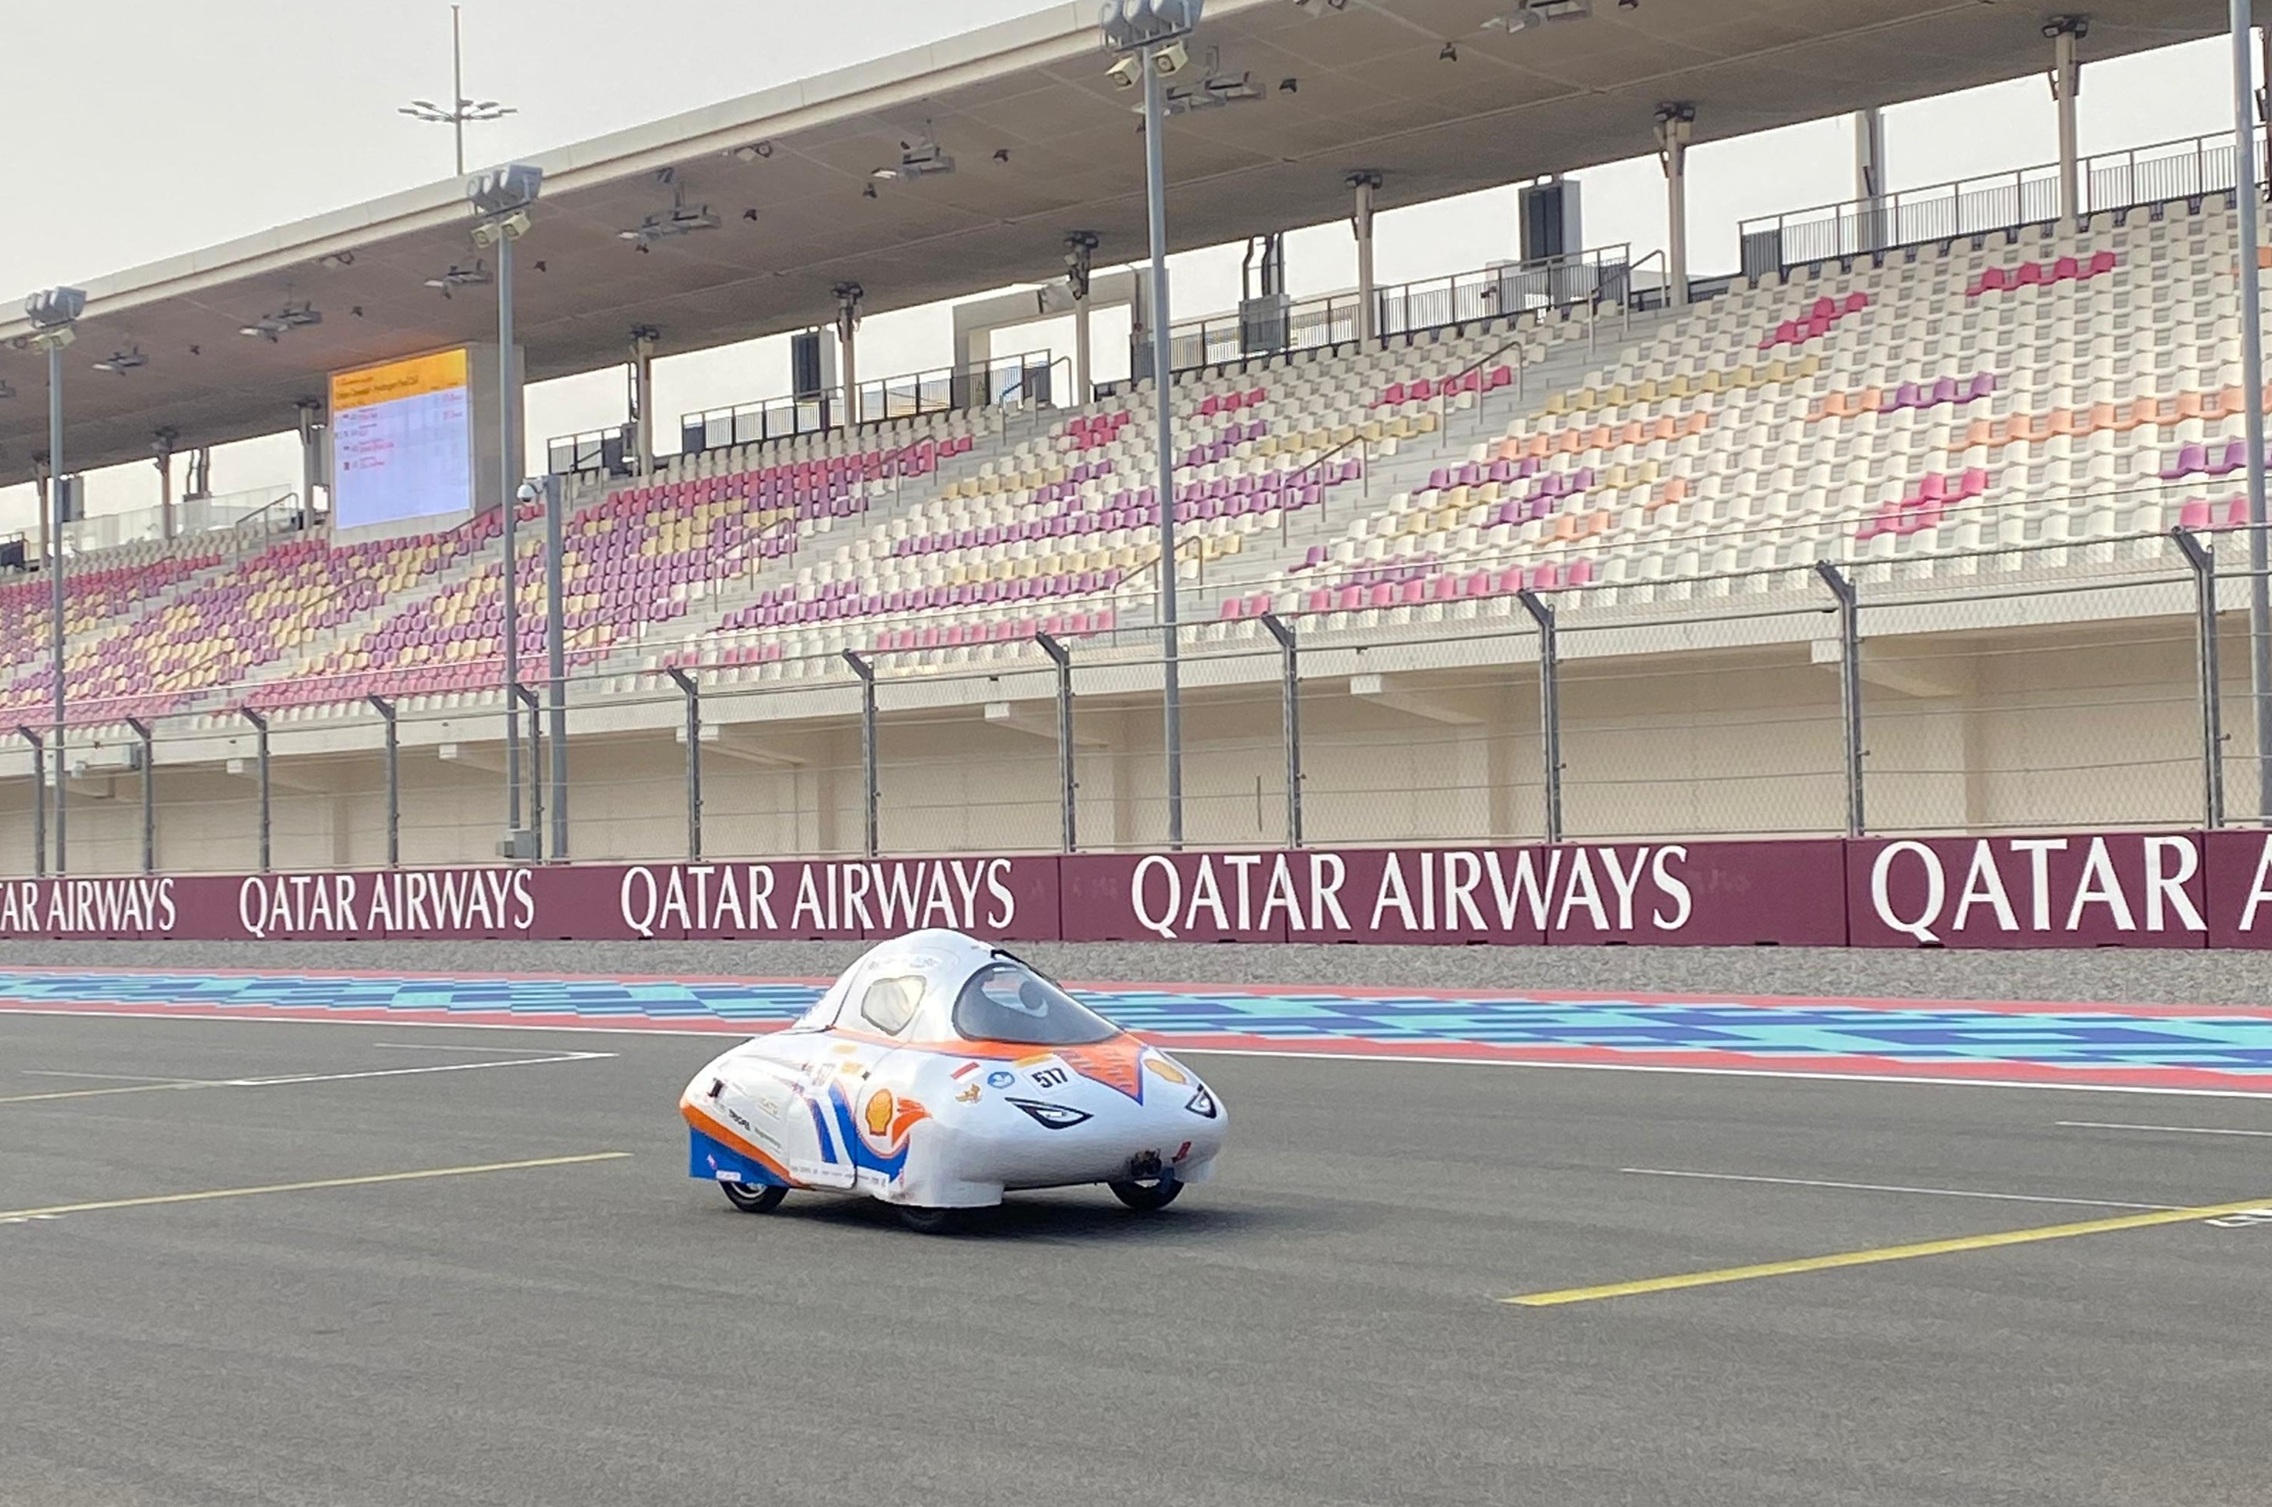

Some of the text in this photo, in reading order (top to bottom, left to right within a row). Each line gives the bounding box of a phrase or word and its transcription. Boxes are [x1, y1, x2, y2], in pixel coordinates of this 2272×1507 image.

[0, 878, 176, 931] AR AIRWAYS
[239, 868, 534, 938] QATAR AIRWAYS
[621, 858, 1015, 937] QATAR AIRWAYS
[1131, 845, 1692, 939] QATAR AIRWAYS
[1871, 835, 2208, 942] QATAR
[1030, 1066, 1069, 1089] 517
